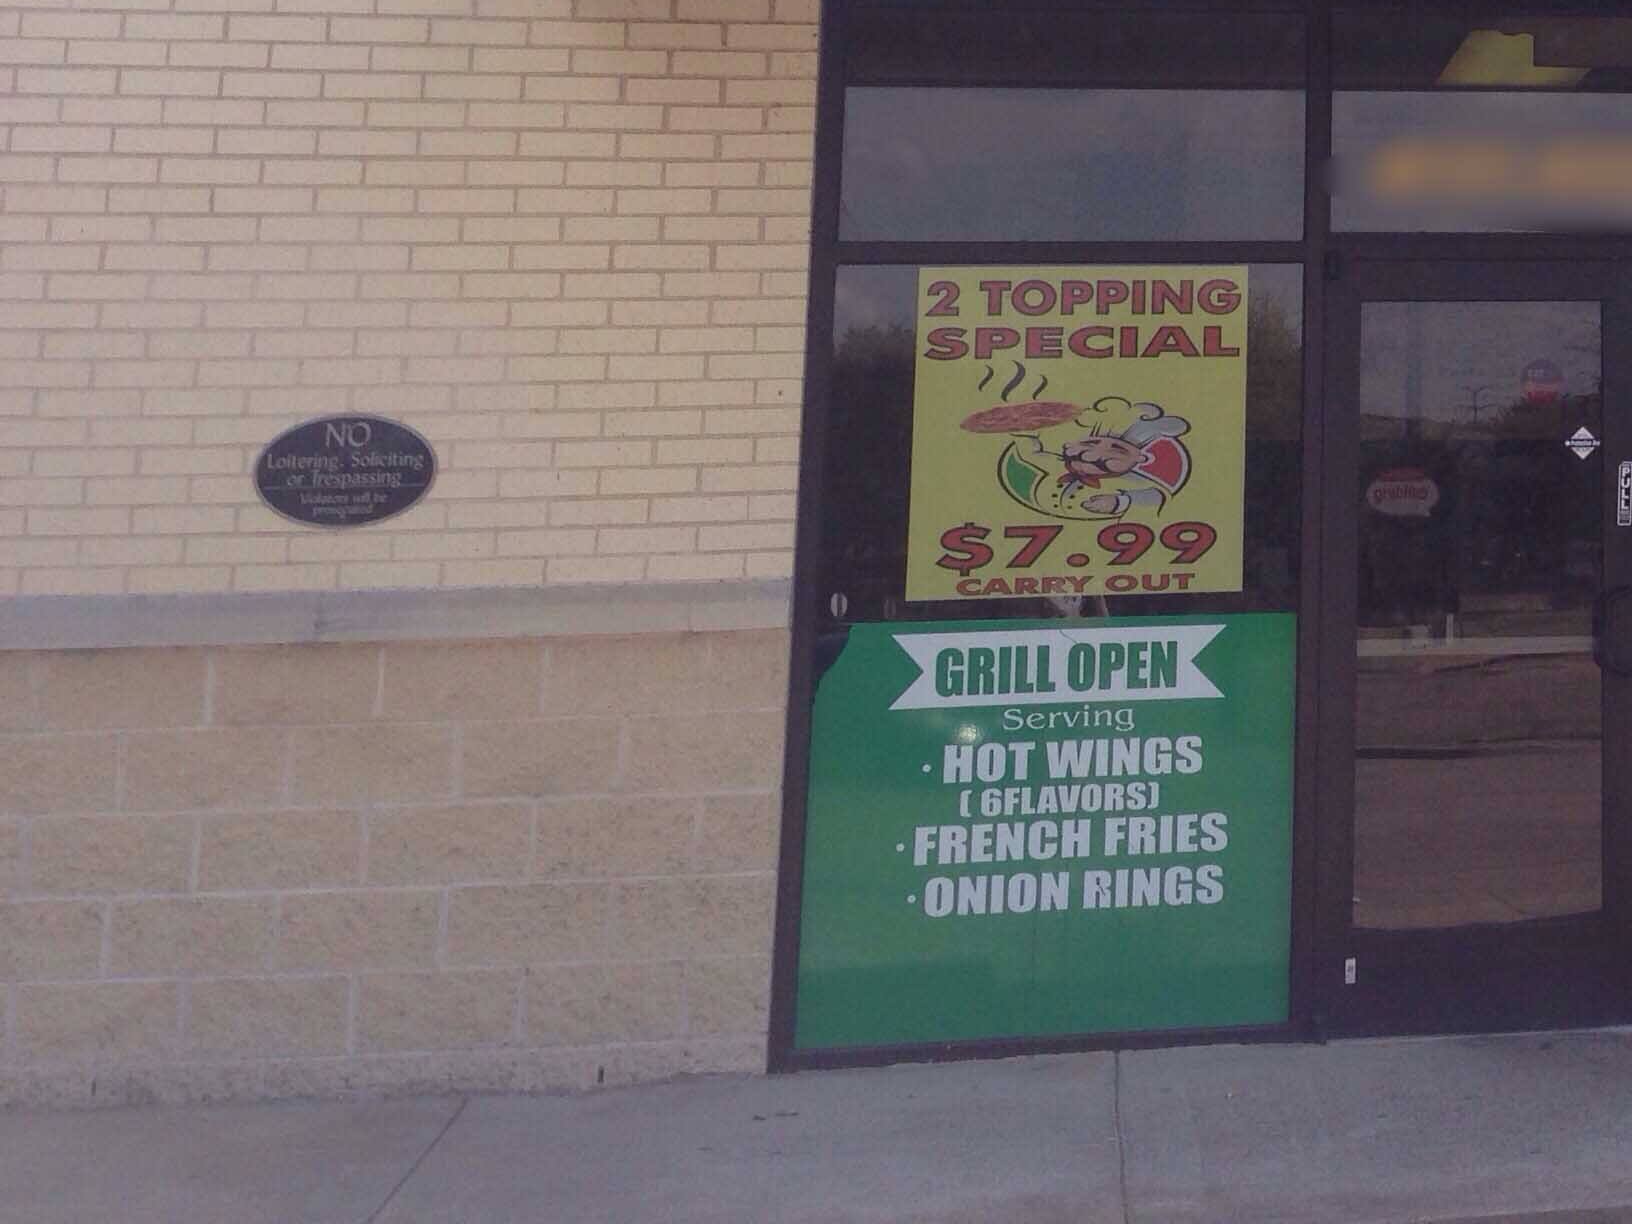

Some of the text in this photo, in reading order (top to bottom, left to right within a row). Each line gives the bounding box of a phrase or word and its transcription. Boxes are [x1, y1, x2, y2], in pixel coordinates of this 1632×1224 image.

[925, 279, 1242, 317] 2 TOPPING
[923, 326, 1240, 360] SPECIAL
[325, 421, 372, 448] NO
[1620, 466, 1631, 510] PULL
[935, 521, 1218, 577] $7.99
[956, 573, 1196, 596] CARRY OUT
[935, 640, 1178, 697] GRILL OPEN
[1002, 704, 1136, 731] Serving
[943, 735, 1203, 784] HOT WINGS
[914, 812, 1229, 866] FRENCH FRIES
[923, 864, 1224, 918] ONION RINGS
